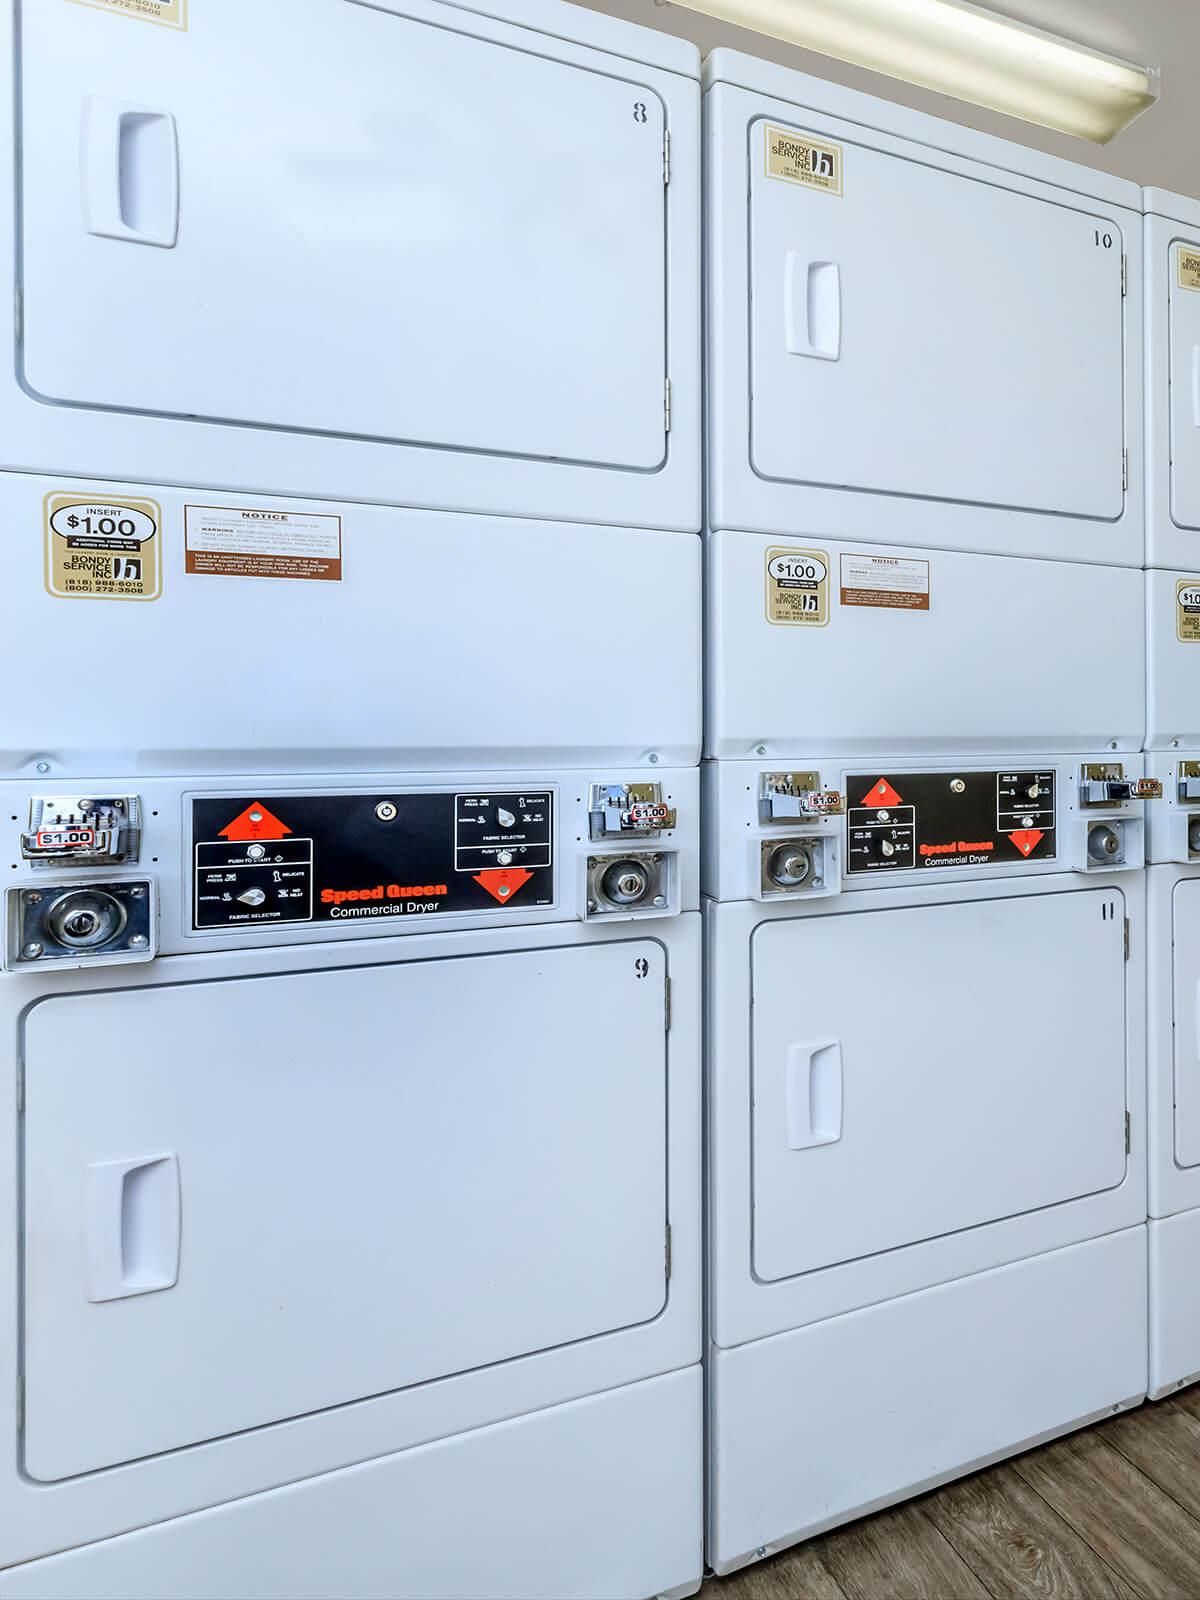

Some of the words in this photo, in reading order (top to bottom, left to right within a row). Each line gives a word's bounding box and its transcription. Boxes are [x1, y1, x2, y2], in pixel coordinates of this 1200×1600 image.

[633, 102, 648, 123] 8
[771, 145, 810, 163] SERVICE
[778, 140, 810, 154] BONDY
[795, 160, 810, 171] INC
[1095, 230, 1112, 249] 10
[86, 508, 122, 516] INSERT
[241, 512, 288, 520] NOTICE
[67, 514, 136, 536] $1.00
[72, 555, 111, 564] BONDY
[63, 562, 111, 572] SERVICE
[777, 563, 816, 579] $1.00
[92, 571, 112, 579] INC
[95, 580, 143, 588] 988-6010
[96, 586, 143, 594] 272-3508
[813, 796, 838, 805] $1.00
[919, 842, 956, 857] Speed
[958, 841, 993, 852] Queen
[925, 855, 967, 866] Commercial
[970, 854, 989, 863] Dryer
[321, 886, 384, 904] Speed
[386, 884, 447, 898] Queen
[330, 903, 403, 918] Commercial
[407, 902, 439, 913] Dryer
[1102, 902, 1114, 920] 11
[635, 958, 649, 979] 9
